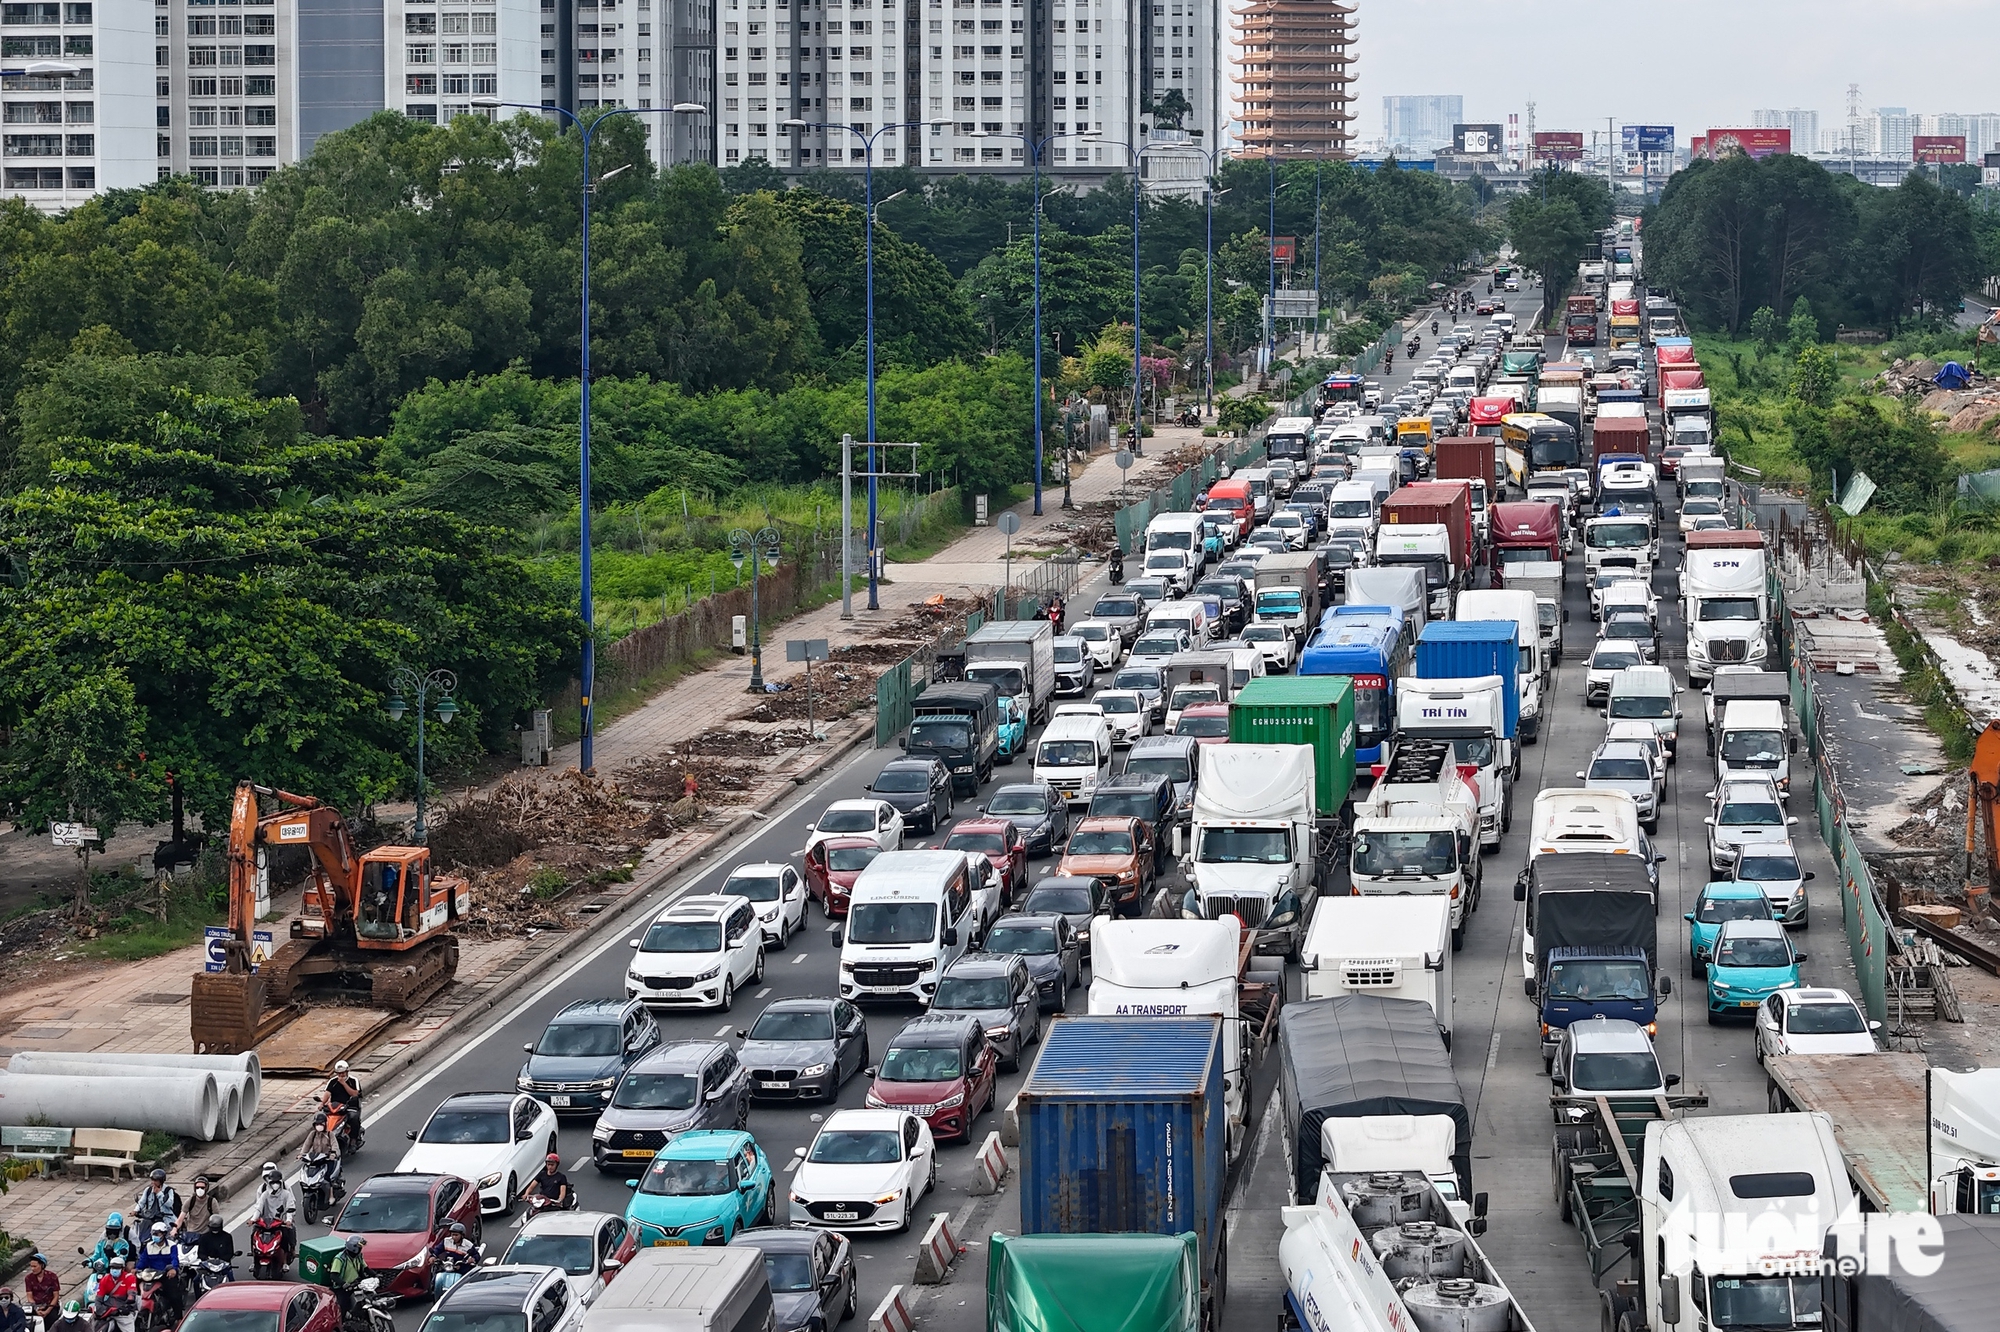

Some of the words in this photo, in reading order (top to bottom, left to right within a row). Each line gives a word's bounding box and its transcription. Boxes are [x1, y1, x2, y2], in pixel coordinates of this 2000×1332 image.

[1354, 678, 1382, 687] ravel
[1421, 706, 1443, 718] TRÍ
[1446, 706, 1468, 718] TÍN
[208, 930, 221, 938] CÔNG
[257, 933, 269, 941] CÔNG
[1115, 1005, 1129, 1014] AA
[1131, 1005, 1188, 1014] TRANSPORT
[1167, 1211, 1174, 1222] 3
